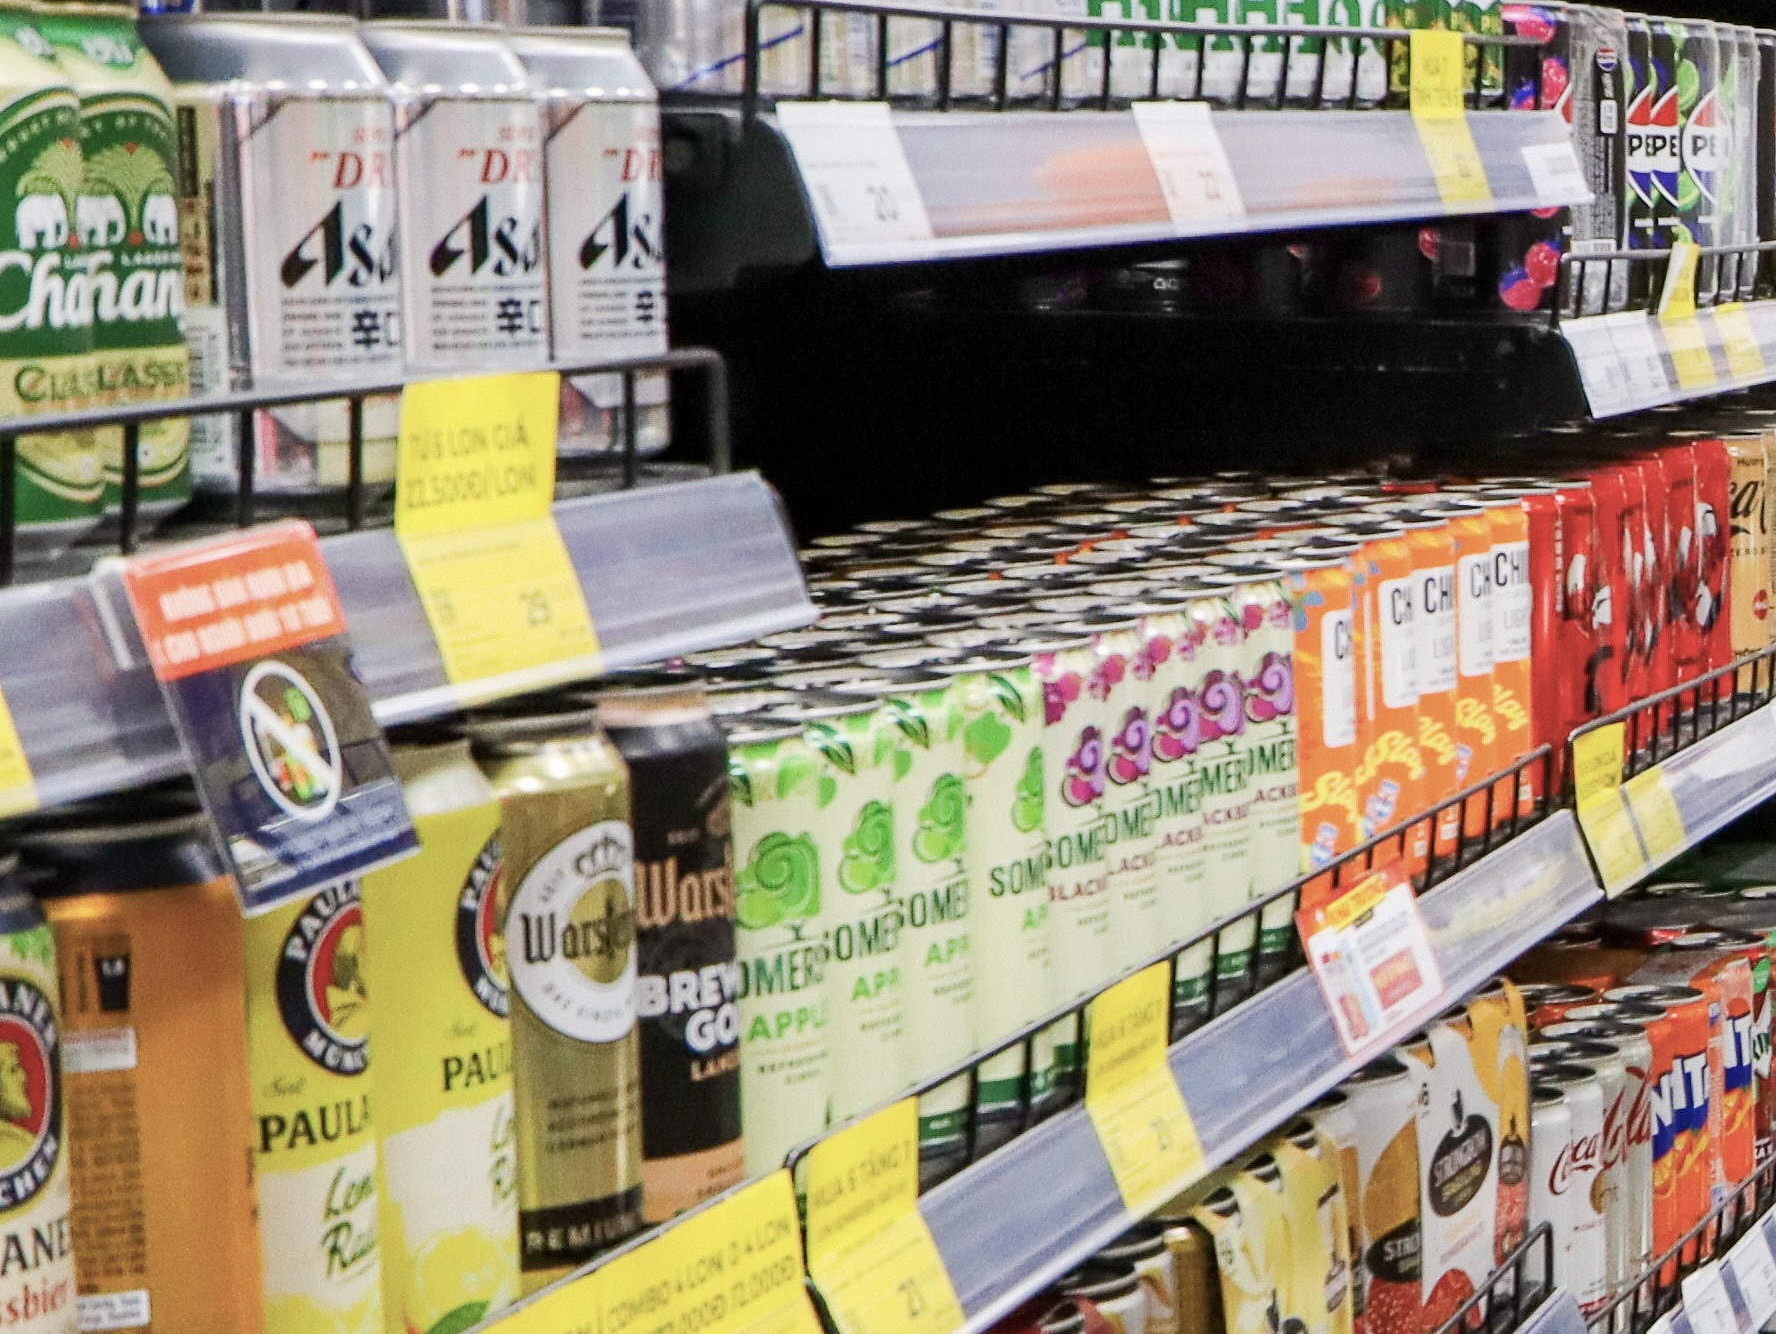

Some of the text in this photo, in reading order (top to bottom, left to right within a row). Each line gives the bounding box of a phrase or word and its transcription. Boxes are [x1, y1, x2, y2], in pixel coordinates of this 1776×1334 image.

[448, 425, 487, 455] LON
[492, 420, 530, 453] GIÁ
[756, 1215, 792, 1247] LON
[607, 1276, 673, 1334] COMBO
[687, 1252, 725, 1290] LON
